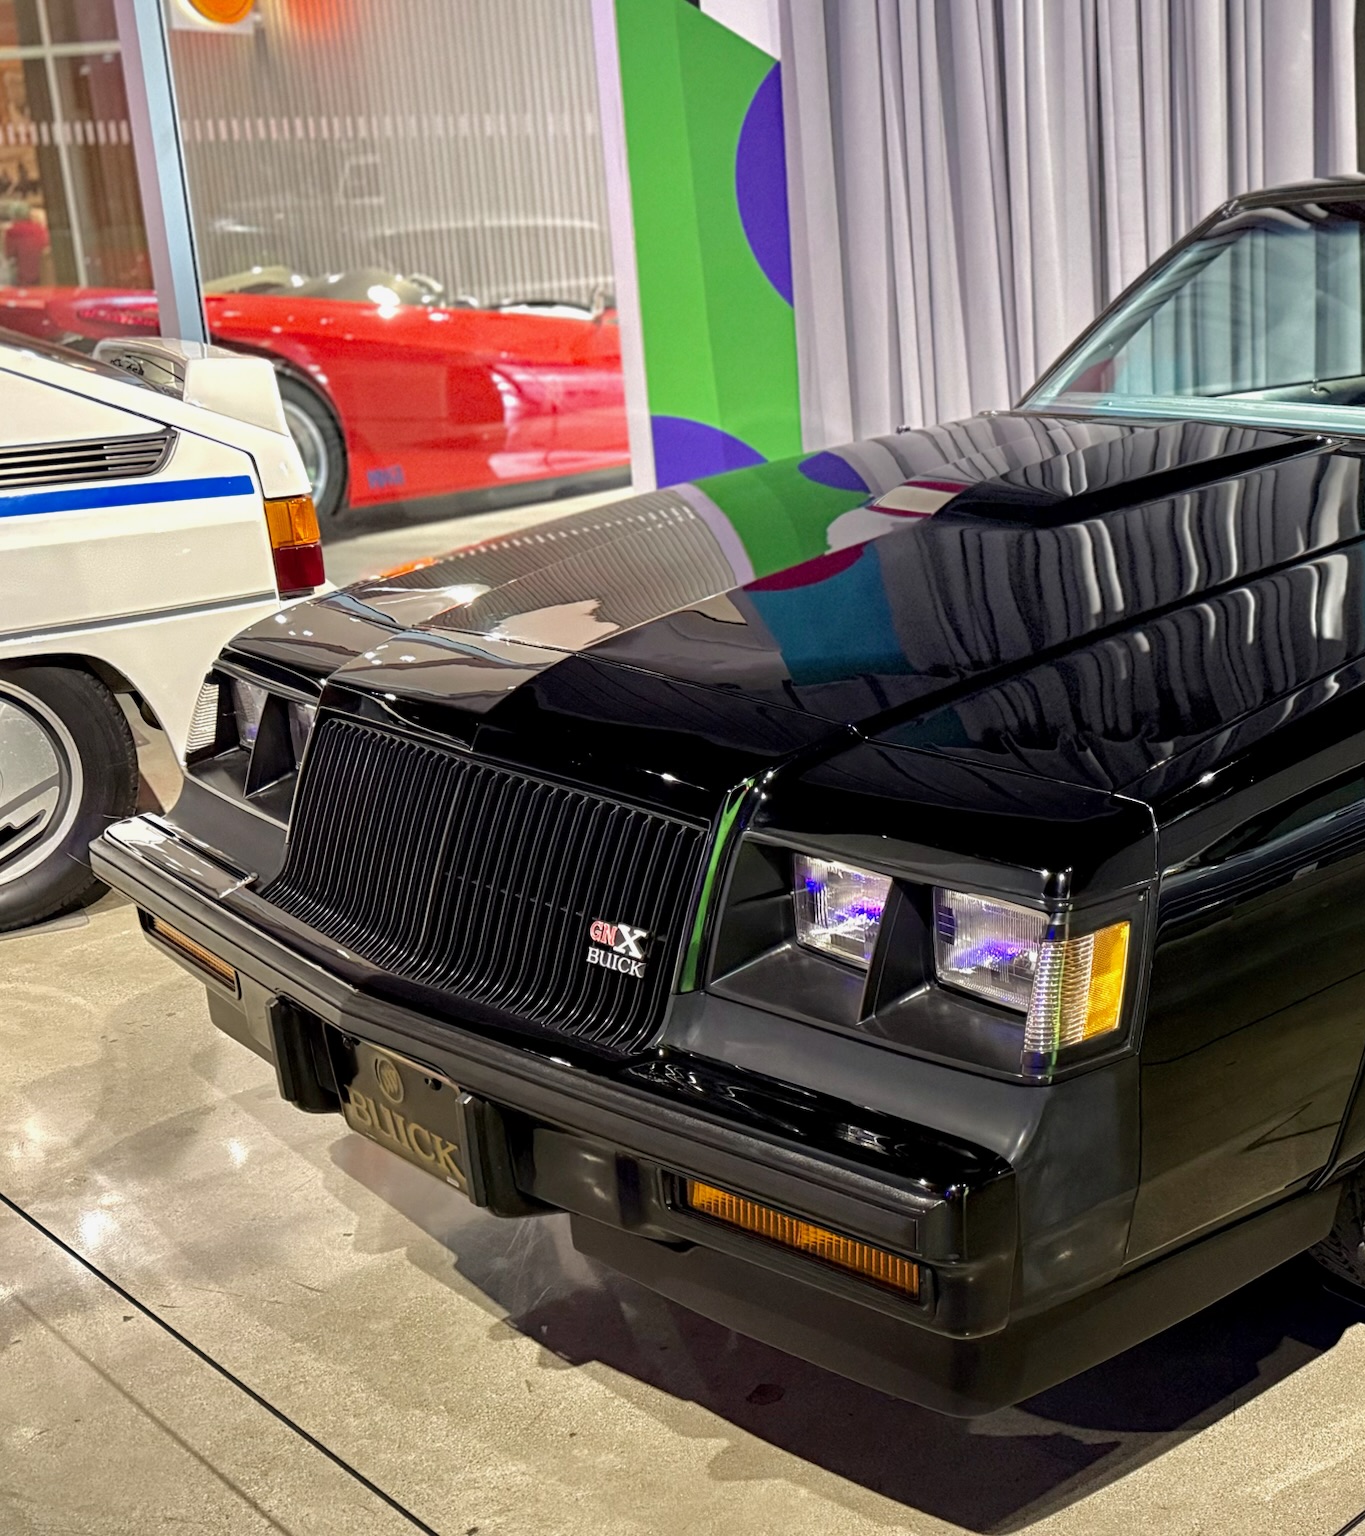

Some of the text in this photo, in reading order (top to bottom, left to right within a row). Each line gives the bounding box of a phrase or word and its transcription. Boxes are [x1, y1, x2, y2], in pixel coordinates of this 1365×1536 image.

[590, 920, 647, 960] GNX
[586, 946, 647, 979] BUICK
[344, 1084, 467, 1182] BUICK
